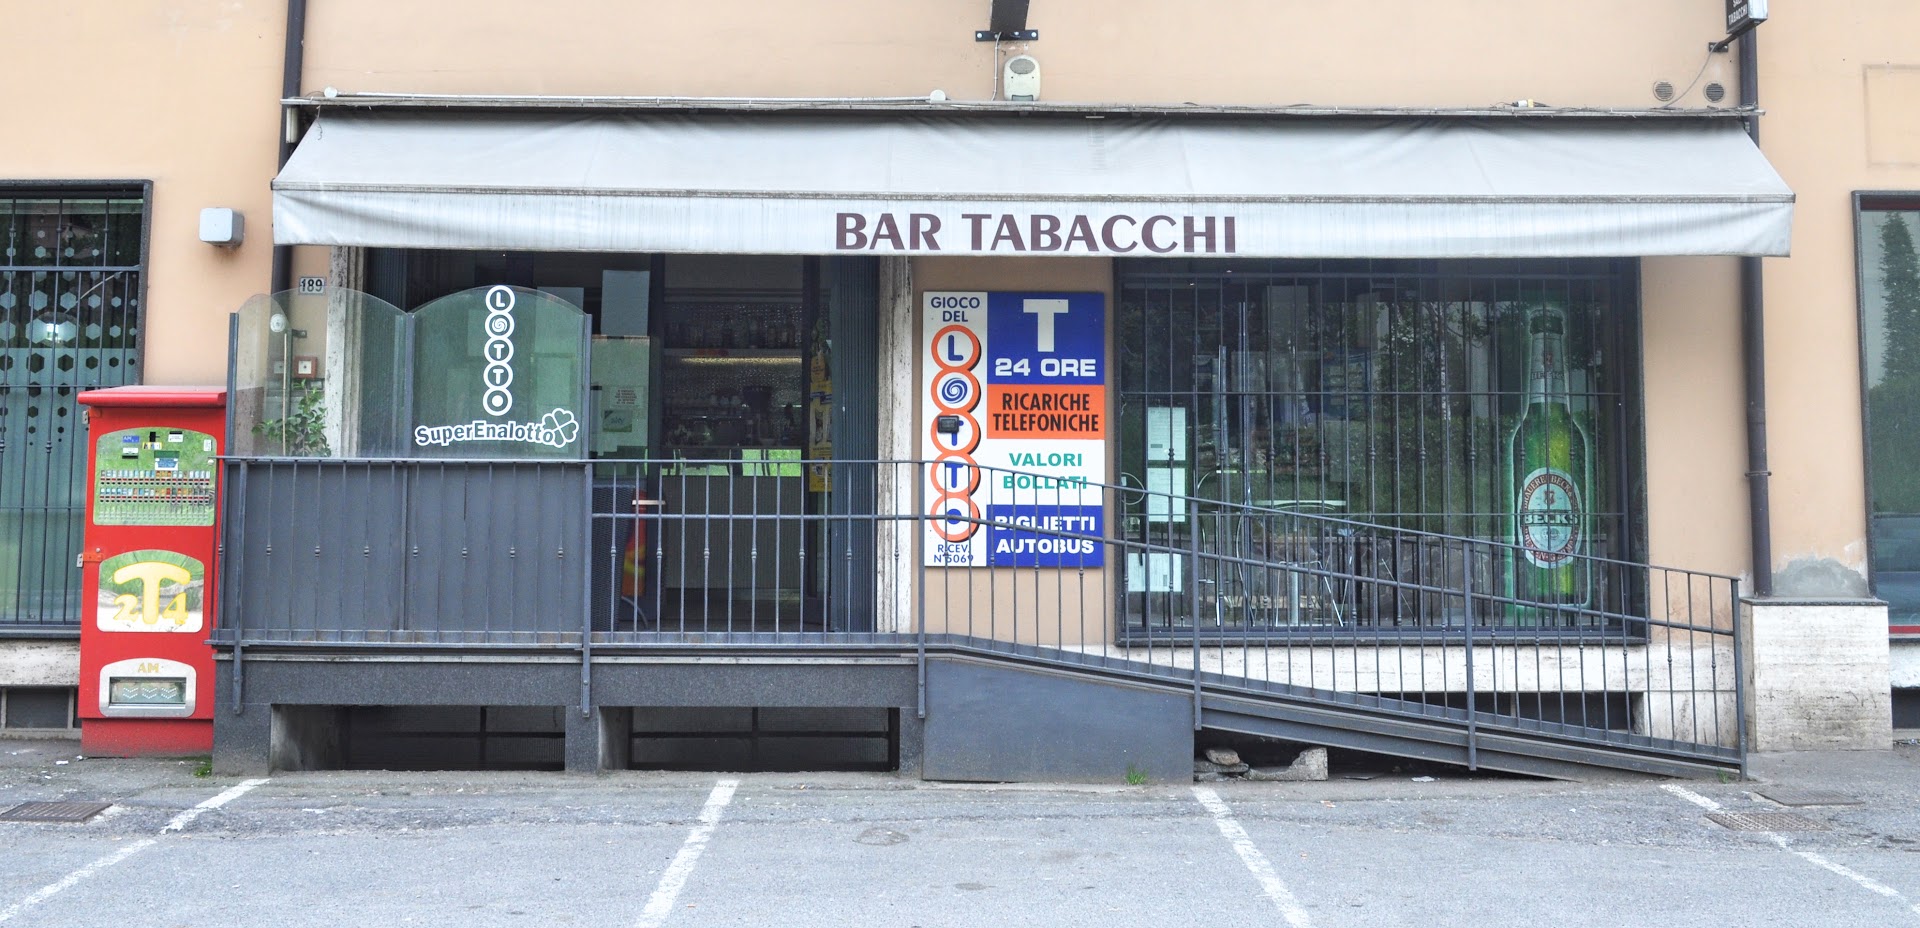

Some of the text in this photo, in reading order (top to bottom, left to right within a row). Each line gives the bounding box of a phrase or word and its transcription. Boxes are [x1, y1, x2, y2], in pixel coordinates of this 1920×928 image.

[1728, 3, 1748, 26] TABACCHI
[835, 212, 1237, 254] BAR TABACCHI
[301, 278, 323, 292] 189
[930, 296, 981, 309] GIOCO
[942, 310, 969, 322] DEL
[1022, 298, 1069, 352] T
[483, 285, 515, 416] LOTTO
[995, 358, 1097, 377] 24 ORE
[1002, 392, 1091, 411] RICARICHE
[993, 413, 1099, 433] TELEFONICHE
[415, 420, 556, 446] SuperEnalotto
[1008, 452, 1083, 467] VALORI
[1003, 475, 1088, 490] BOLLATI
[937, 543, 971, 553] RCEV.
[995, 537, 1095, 554] AUTOBUS
[933, 554, 974, 563] N5069
